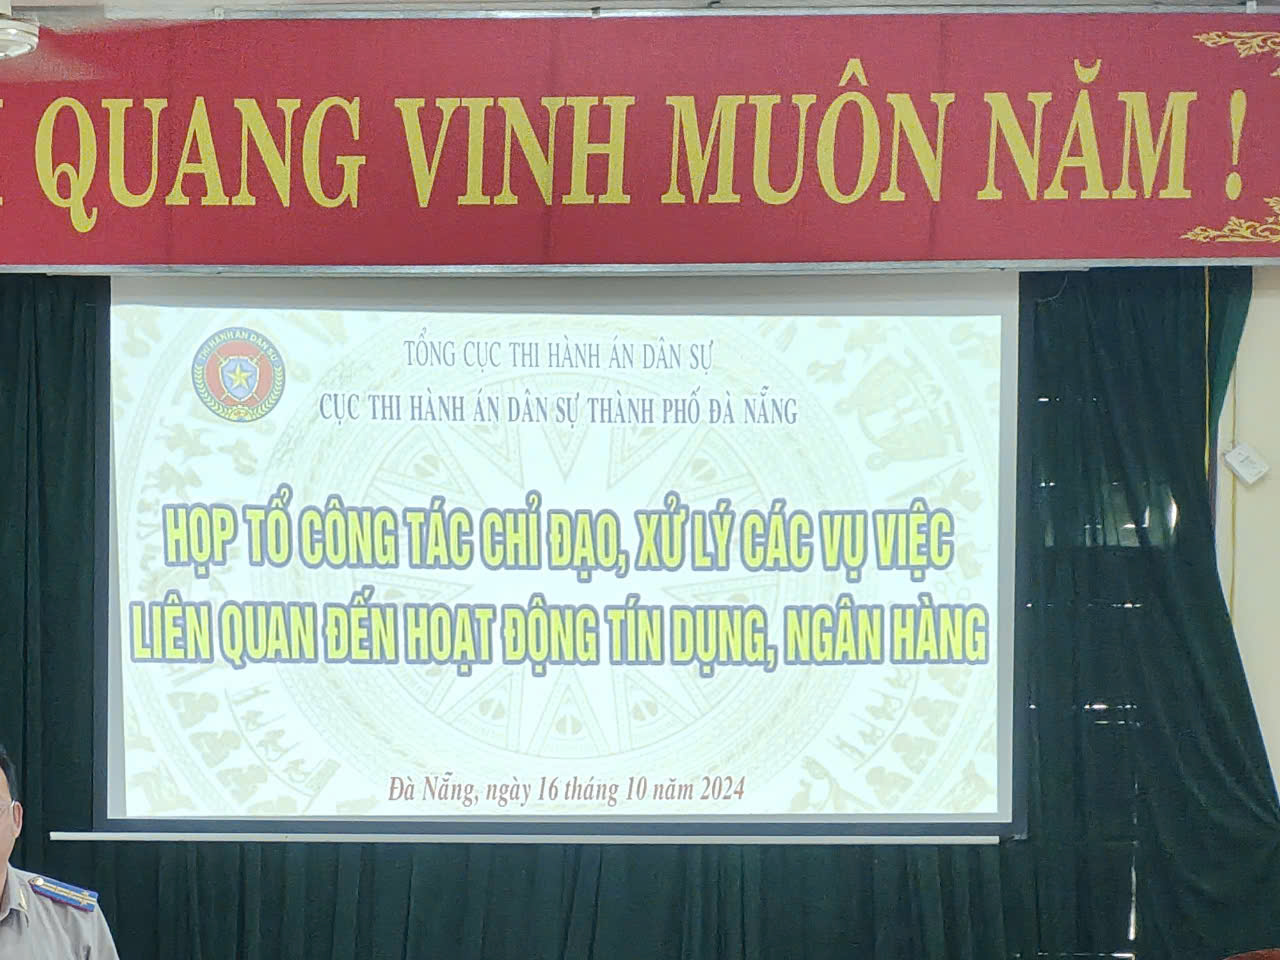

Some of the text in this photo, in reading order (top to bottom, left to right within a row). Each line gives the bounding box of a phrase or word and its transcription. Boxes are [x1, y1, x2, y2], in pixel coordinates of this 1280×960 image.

[35, 96, 366, 234] QUANG
[395, 96, 635, 207] VINH
[667, 58, 956, 205] MUÔN
[985, 58, 1197, 201] NĂM
[1225, 90, 1247, 200] !
[404, 327, 714, 375] TỔNG CỤC THI HÀNH ÁN DÂN SỰ
[319, 385, 798, 429] CỤC THI HÀNH ÁN DÂN SỰ THÀNH PHỐ ĐÀ NẴNG
[163, 483, 954, 583] HỌP TỔ CÔNG TÁC CHỈ ĐẠO, XỬ LÝ CÁC VỤ VIỆC
[130, 584, 989, 678] LIÊN QUAN ĐẾN HOẠT ĐỘNG TÍN DỤNG, NGÂN HÀNG
[388, 771, 746, 808] Đà Nẵng, ngày 16 tháng 10 năm 2024
